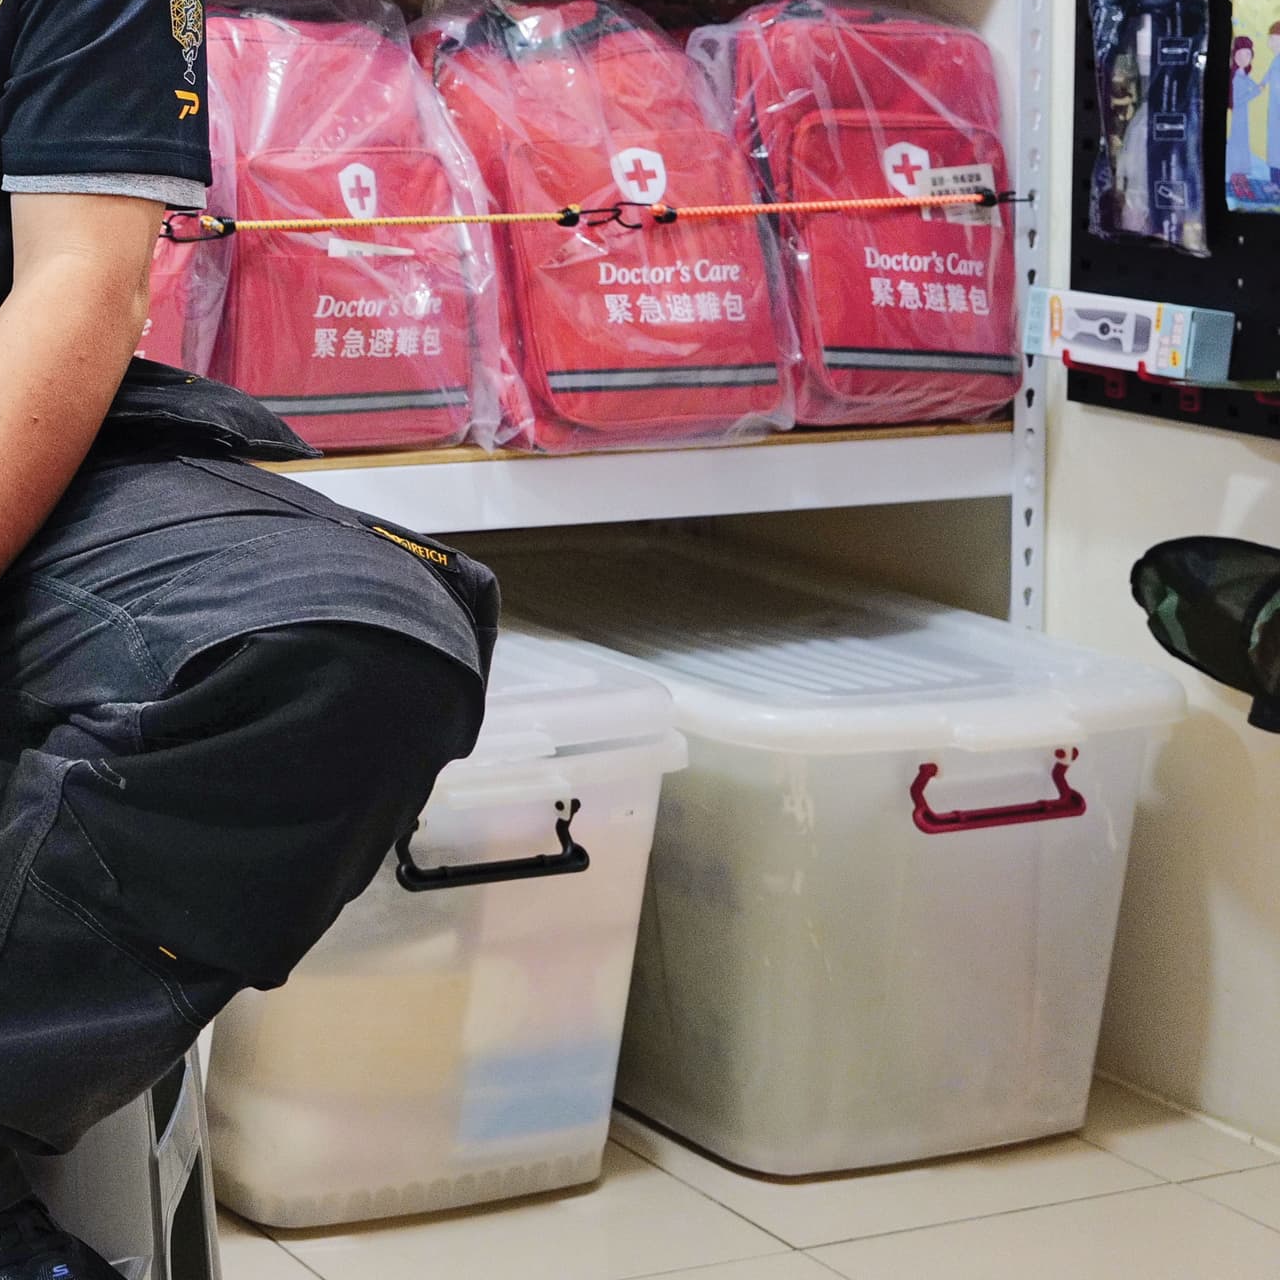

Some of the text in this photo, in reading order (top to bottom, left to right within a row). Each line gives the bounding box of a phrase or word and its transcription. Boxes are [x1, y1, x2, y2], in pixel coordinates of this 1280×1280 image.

[598, 259, 740, 286] Doctor's Care
[863, 247, 985, 277] Doctor's Care
[313, 295, 399, 318] Doctor's
[604, 291, 747, 325] 緊急避難包
[870, 277, 990, 316] 緊急避難包
[312, 326, 442, 358] 緊急避難包
